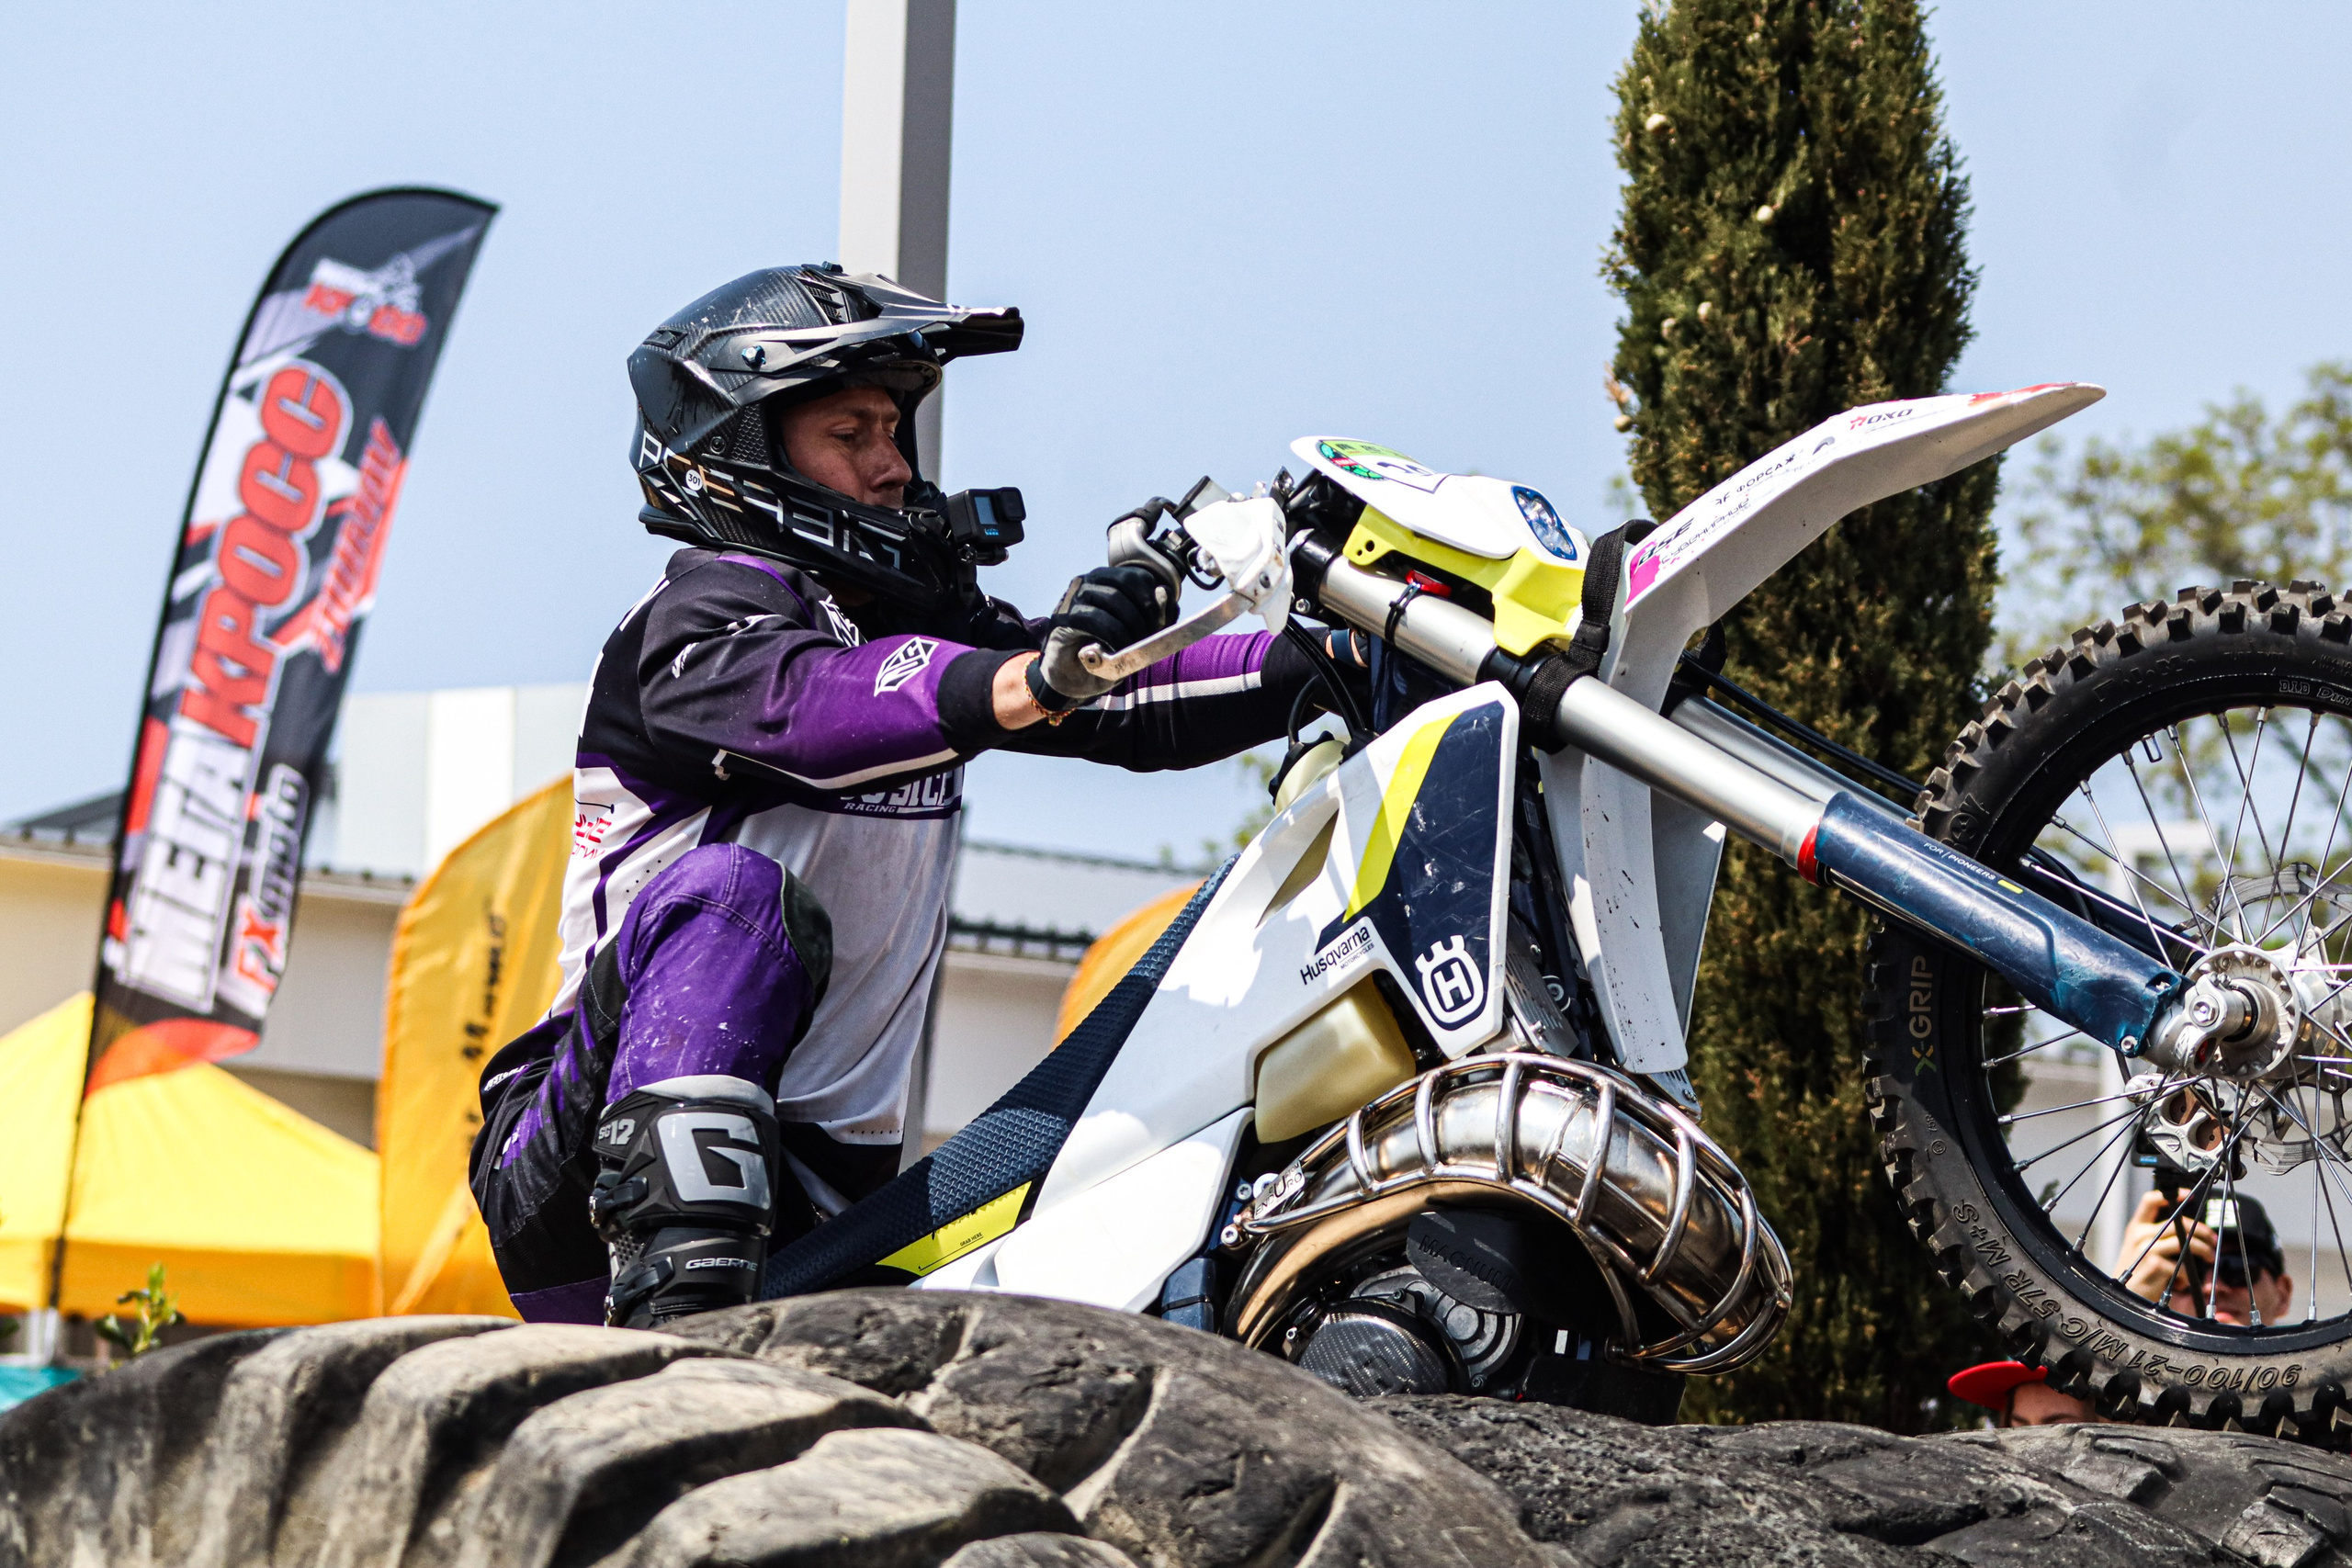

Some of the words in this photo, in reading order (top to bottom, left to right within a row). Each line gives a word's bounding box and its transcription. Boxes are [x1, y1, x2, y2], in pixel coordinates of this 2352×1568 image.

[686, 472, 702, 487] 301
[843, 802, 898, 814] RACING
[1948, 853, 1996, 880] PIONEERS
[1299, 926, 1371, 986] Husqvarna
[1340, 942, 1375, 970] MOTORCYCLES
[1908, 954, 1937, 1077] X-GRIP
[959, 1237, 972, 1247] GRAB
[971, 1232, 983, 1241] HERE
[1951, 1201, 2012, 1268] M+S
[1418, 1234, 1513, 1292] MAGNUM
[2004, 1269, 2062, 1320] 57R
[2060, 1316, 2130, 1361] M/C
[2127, 1349, 2302, 1393] 90/100-21
